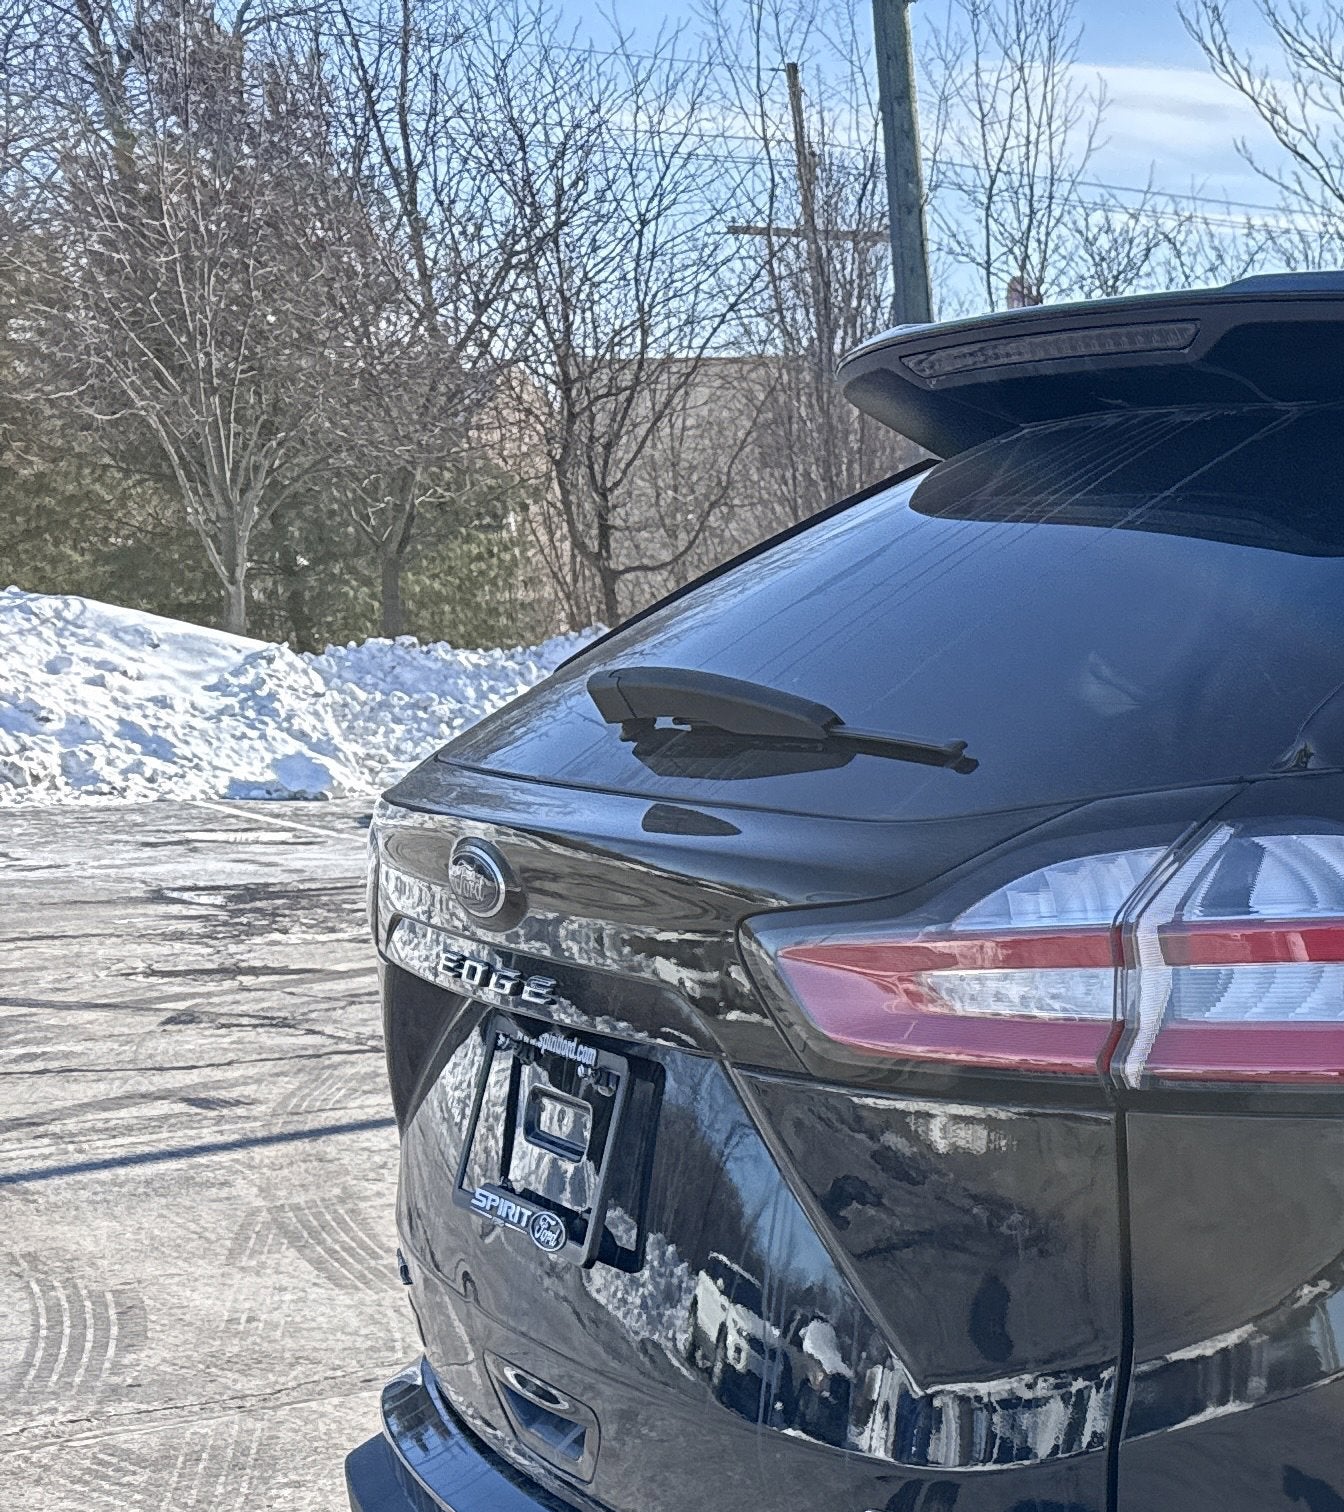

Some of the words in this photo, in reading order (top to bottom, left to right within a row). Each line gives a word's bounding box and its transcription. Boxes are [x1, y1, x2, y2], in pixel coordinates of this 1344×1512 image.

[438, 953, 557, 1005] EDGE
[470, 1187, 533, 1228] SPIRIT
[535, 1214, 561, 1247] Ford
